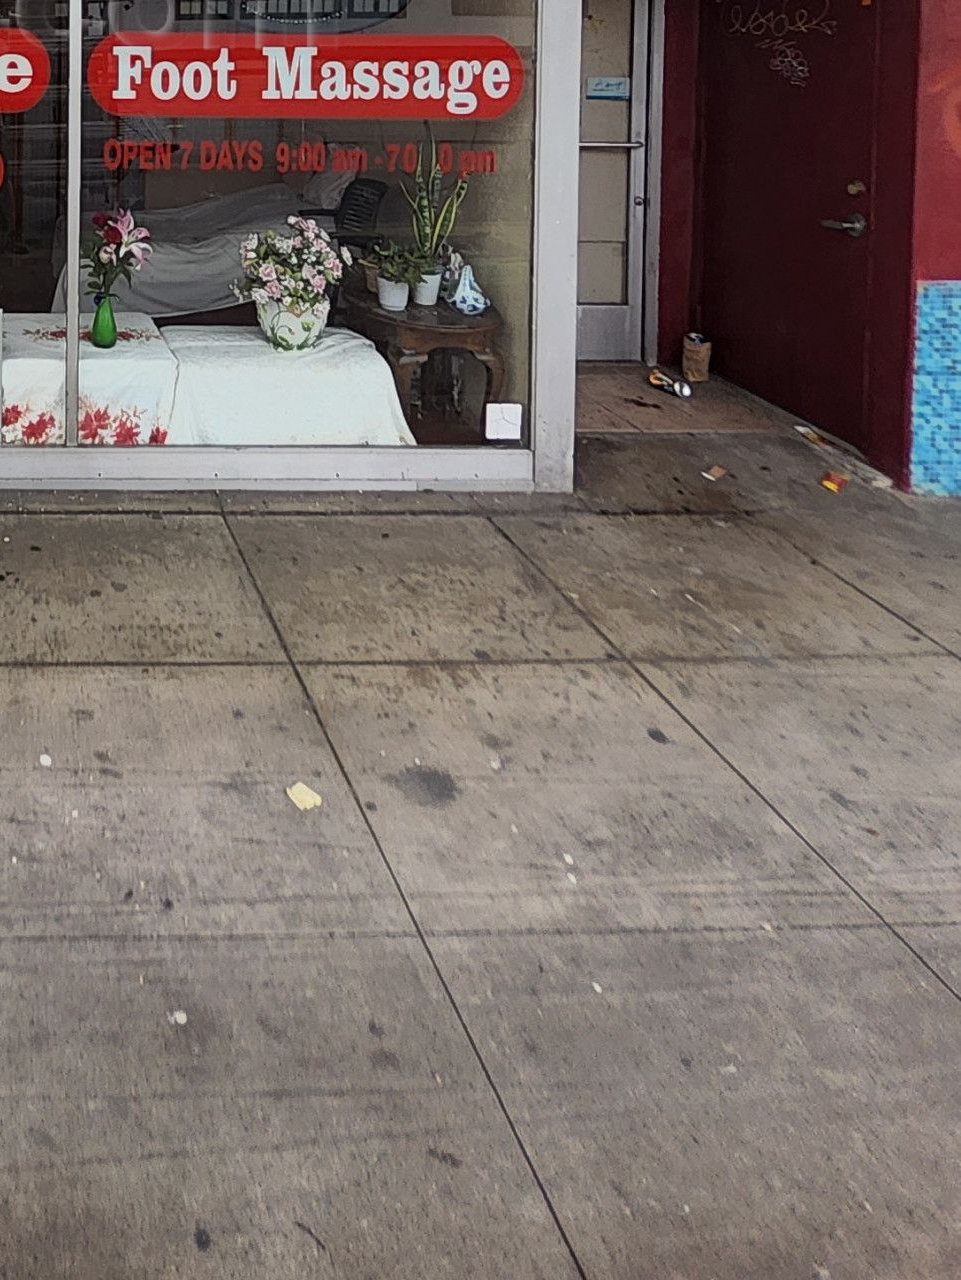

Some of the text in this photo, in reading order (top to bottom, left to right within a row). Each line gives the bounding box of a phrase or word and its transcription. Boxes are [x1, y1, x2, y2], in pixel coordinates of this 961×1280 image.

[112, 46, 511, 114] Foot Massage
[103, 139, 172, 171] OPEN
[180, 140, 194, 170] 7
[199, 140, 264, 172] DAYS
[276, 142, 326, 173] 9:00
[332, 148, 367, 172] am
